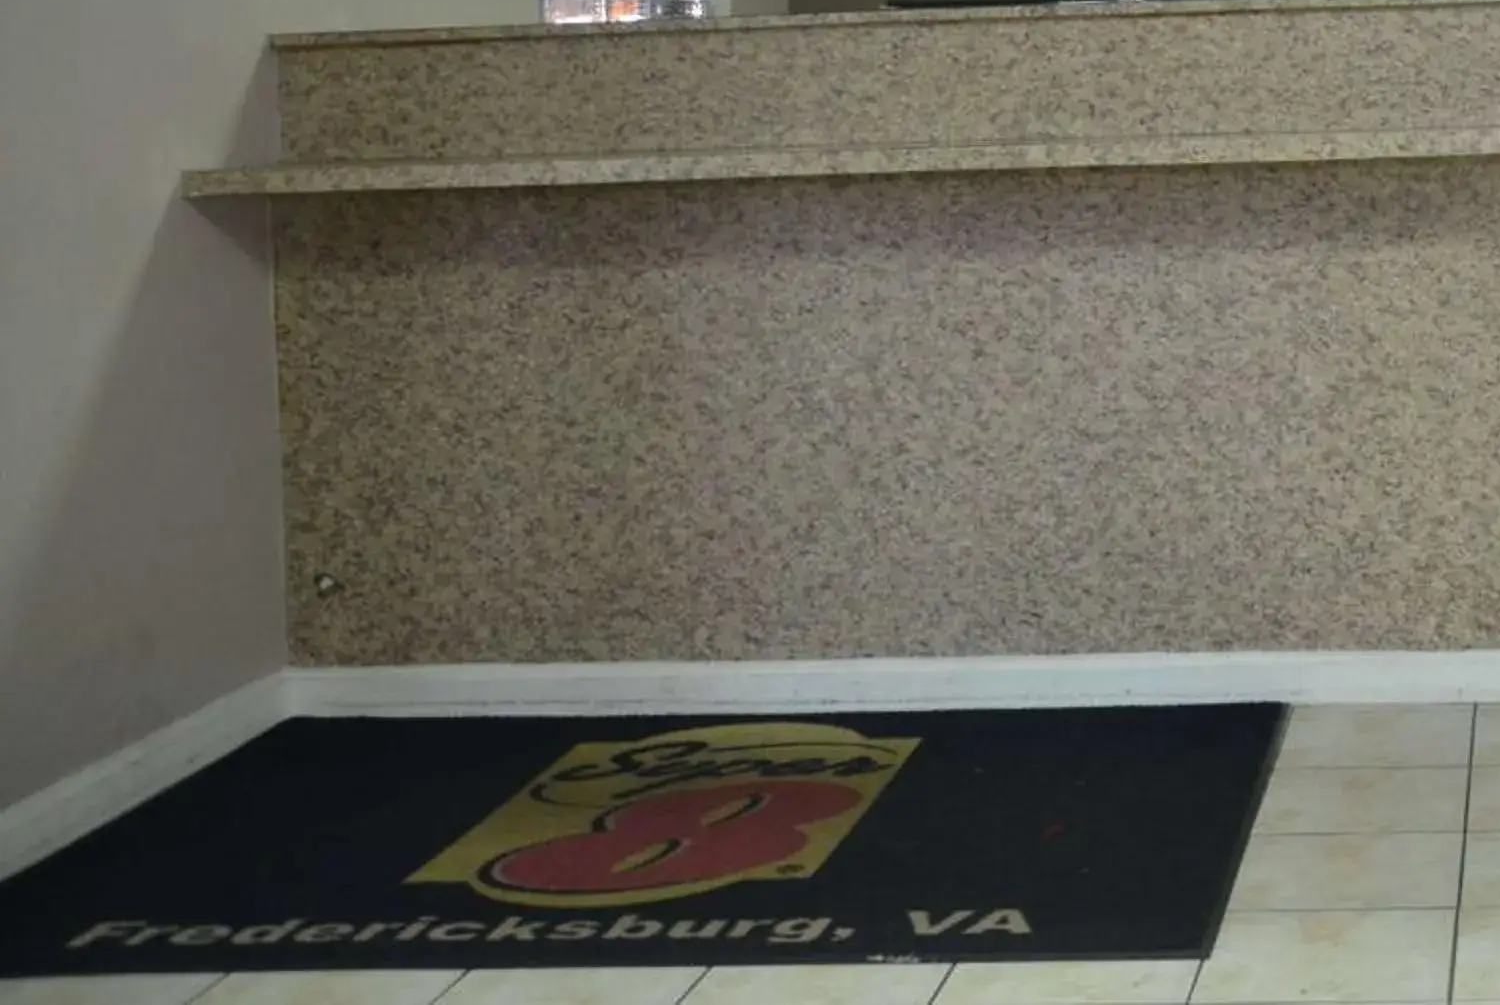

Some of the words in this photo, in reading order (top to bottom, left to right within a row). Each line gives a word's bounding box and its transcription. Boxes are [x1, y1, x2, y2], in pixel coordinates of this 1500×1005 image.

[530, 740, 898, 807] Super
[476, 779, 864, 892] 8
[66, 914, 856, 949] Fredericksburg,
[906, 909, 1032, 936] VA
